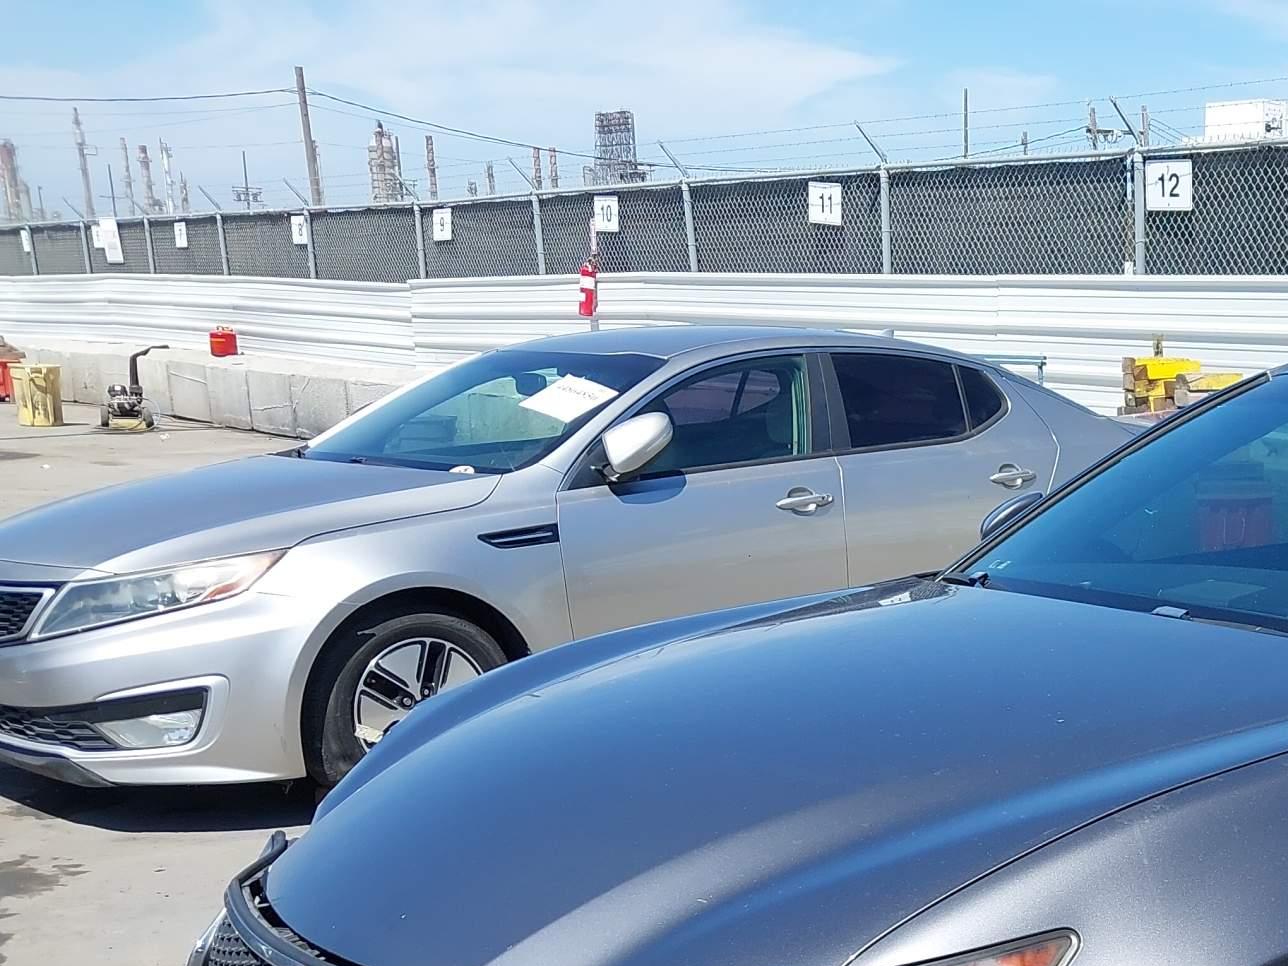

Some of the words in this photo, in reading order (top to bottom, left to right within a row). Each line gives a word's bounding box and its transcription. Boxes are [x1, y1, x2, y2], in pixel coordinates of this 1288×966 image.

[1157, 173, 1181, 198] 12
[600, 204, 613, 223] 10
[818, 193, 834, 214] 11
[439, 216, 446, 232] 9
